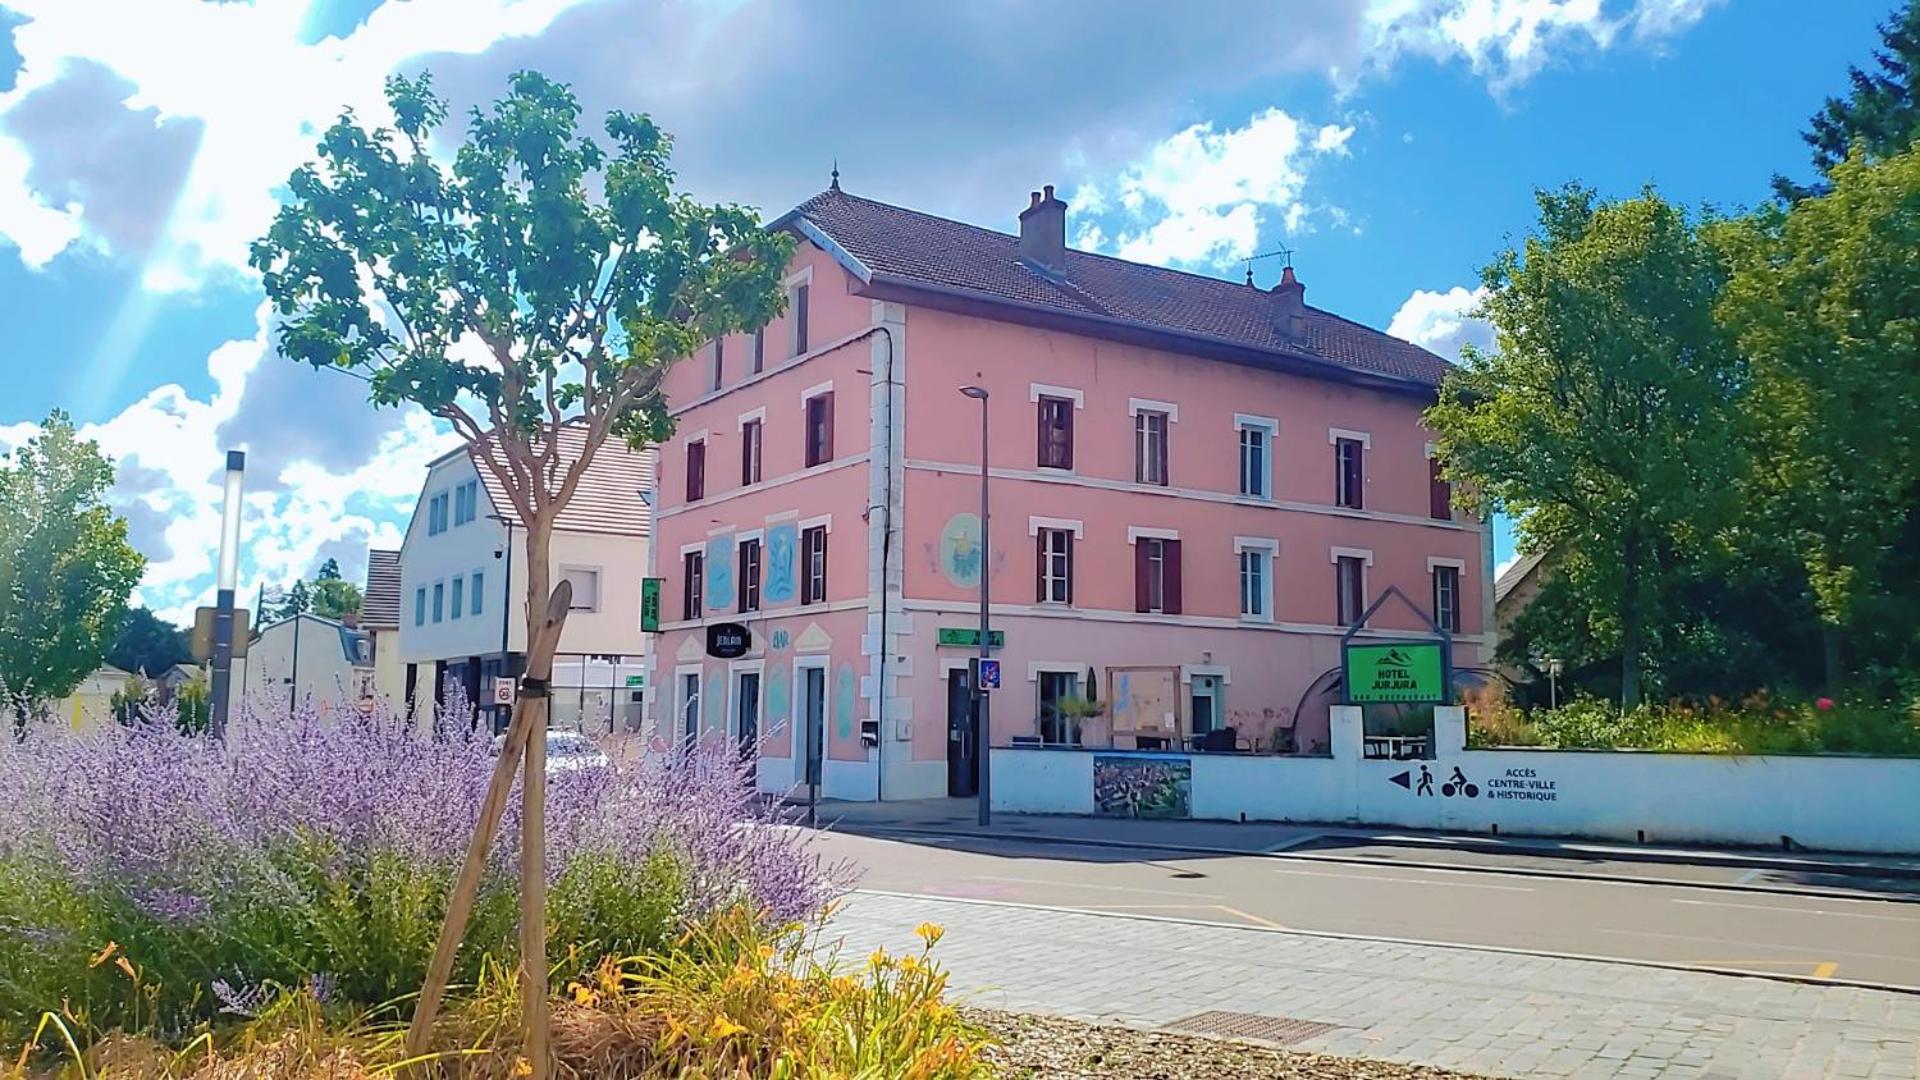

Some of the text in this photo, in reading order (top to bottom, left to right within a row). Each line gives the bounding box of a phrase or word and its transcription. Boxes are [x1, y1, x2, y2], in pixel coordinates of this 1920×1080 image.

[1378, 669, 1410, 679] HOTEL
[1371, 680, 1417, 690] JURJURA
[1506, 768, 1537, 778] ACCÈS
[1488, 779, 1556, 789] CENTRE-VILLE
[1488, 790, 1557, 801] & HISTORIQUE
